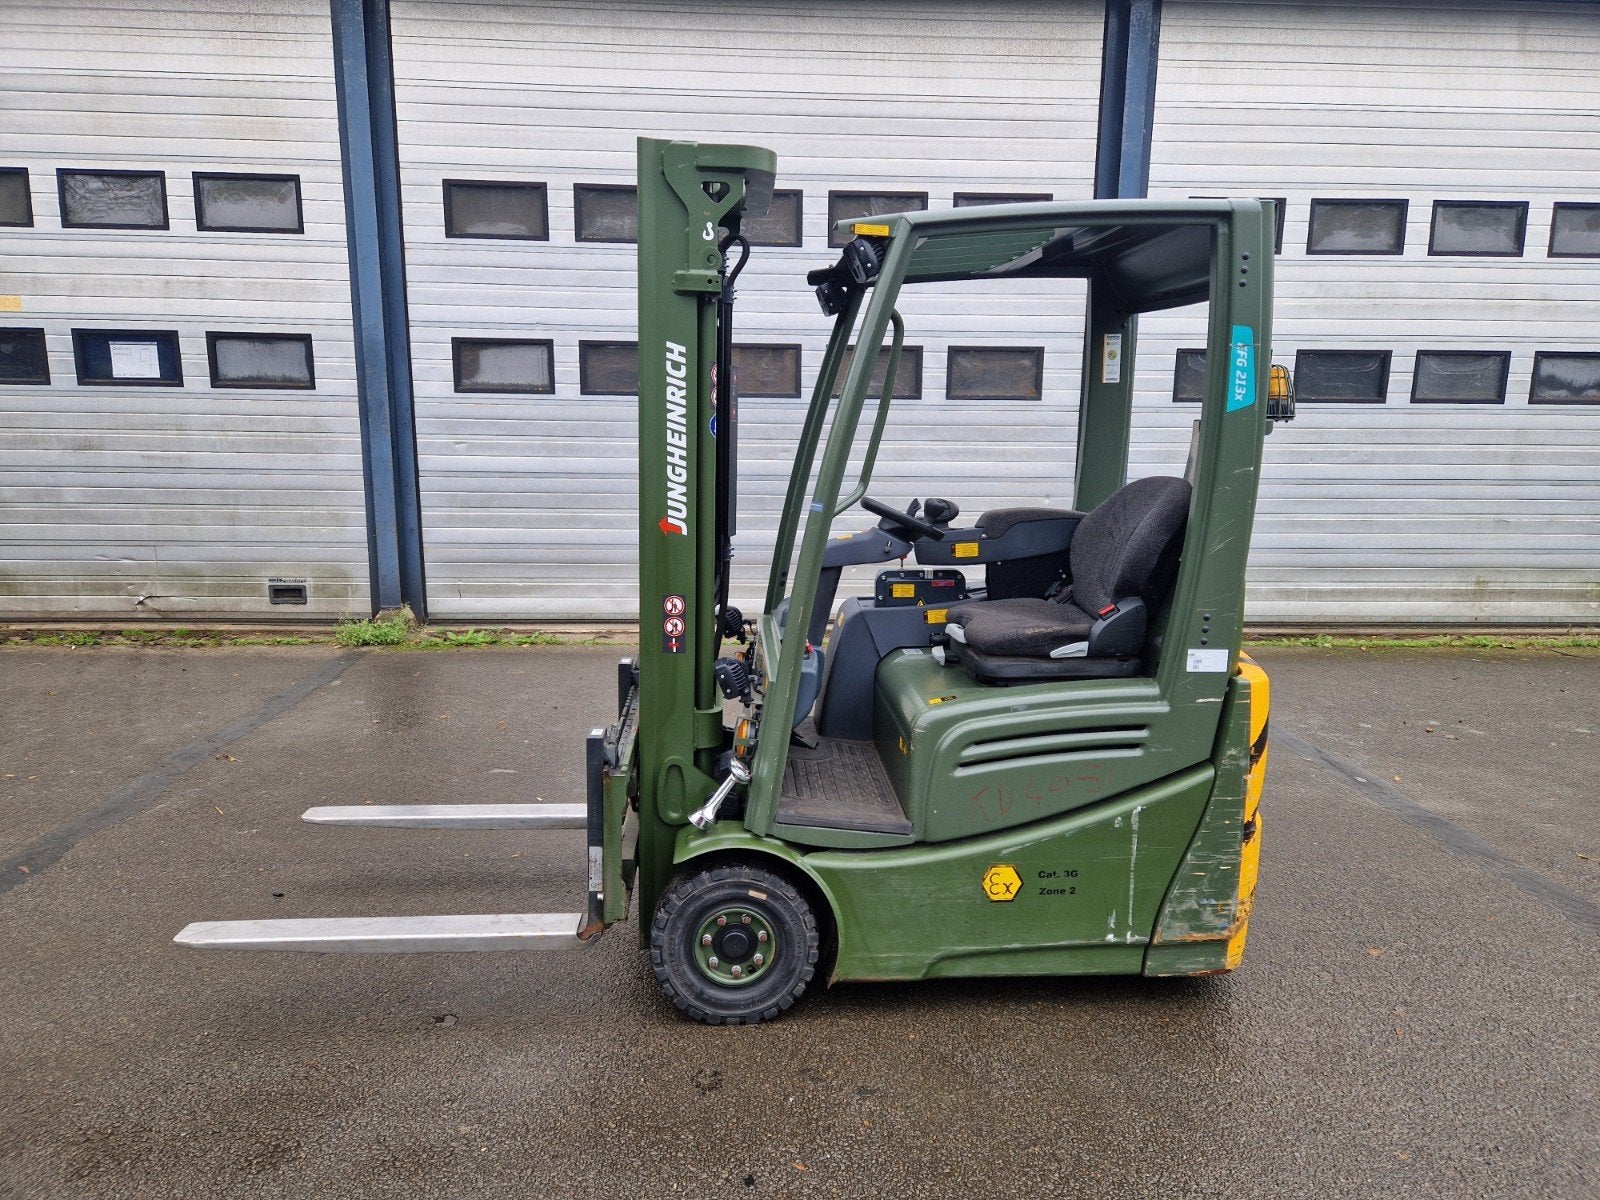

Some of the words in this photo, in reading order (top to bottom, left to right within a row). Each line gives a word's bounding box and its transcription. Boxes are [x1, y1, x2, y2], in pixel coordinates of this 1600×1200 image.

[1236, 342, 1248, 367] EFG
[1234, 370, 1247, 402] 213x
[658, 340, 688, 536] JUNGHEINRICH
[1038, 870, 1060, 879] Cat.
[1063, 869, 1079, 878] 3G
[1039, 887, 1067, 896] Zone
[1069, 886, 1077, 895] 2
